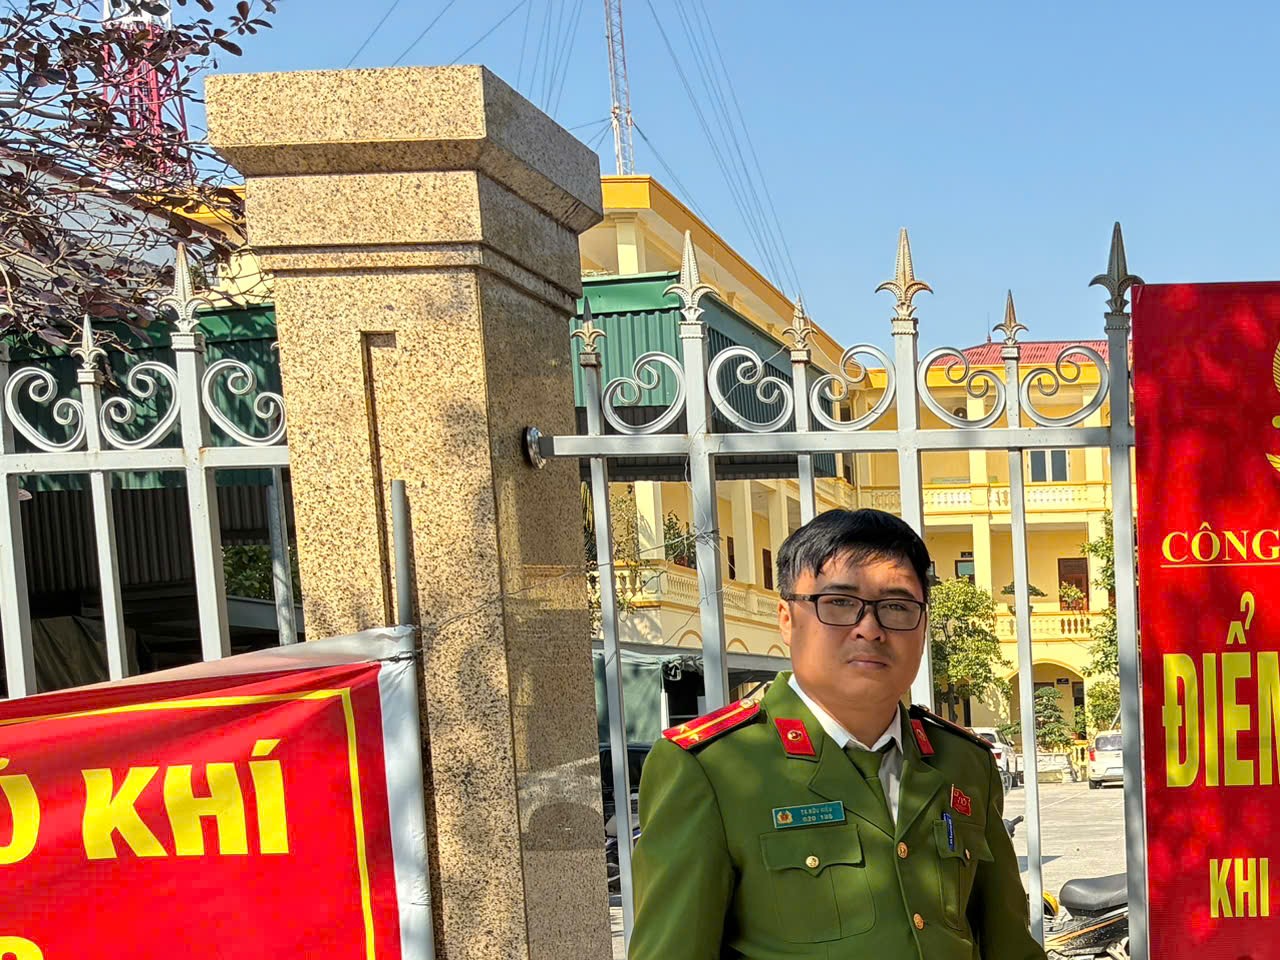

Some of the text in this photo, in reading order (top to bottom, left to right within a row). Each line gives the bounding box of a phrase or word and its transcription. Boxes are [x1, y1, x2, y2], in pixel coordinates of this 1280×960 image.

[1161, 521, 1280, 561] CÔNG
[81, 738, 289, 859] KHÍ
[1209, 857, 1269, 918] KHI
